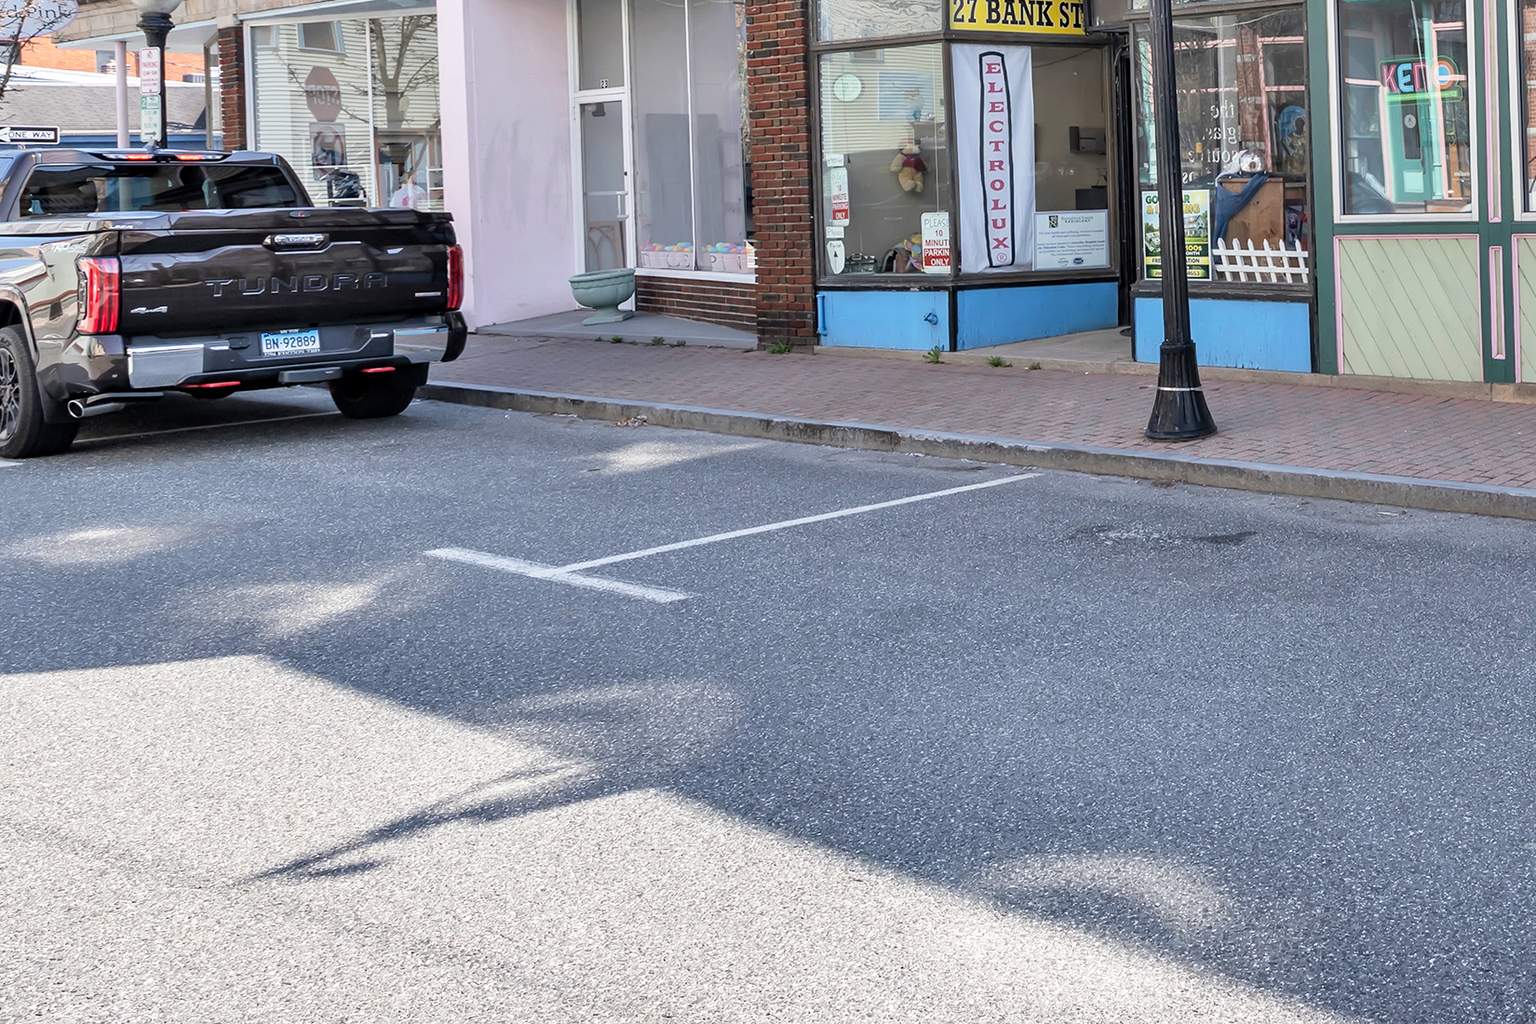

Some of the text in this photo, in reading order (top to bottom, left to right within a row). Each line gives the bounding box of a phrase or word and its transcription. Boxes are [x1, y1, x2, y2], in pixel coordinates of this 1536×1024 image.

[1382, 60, 1454, 93] KENO
[601, 79, 608, 88] 23
[985, 62, 1009, 249] ELECTROLUX
[935, 229, 943, 237] 10
[925, 239, 949, 247] MINUT
[924, 248, 950, 256] PARKIN
[930, 258, 950, 266] ONLY
[205, 272, 388, 296] TUNDRA
[265, 336, 316, 349] BN-92889
